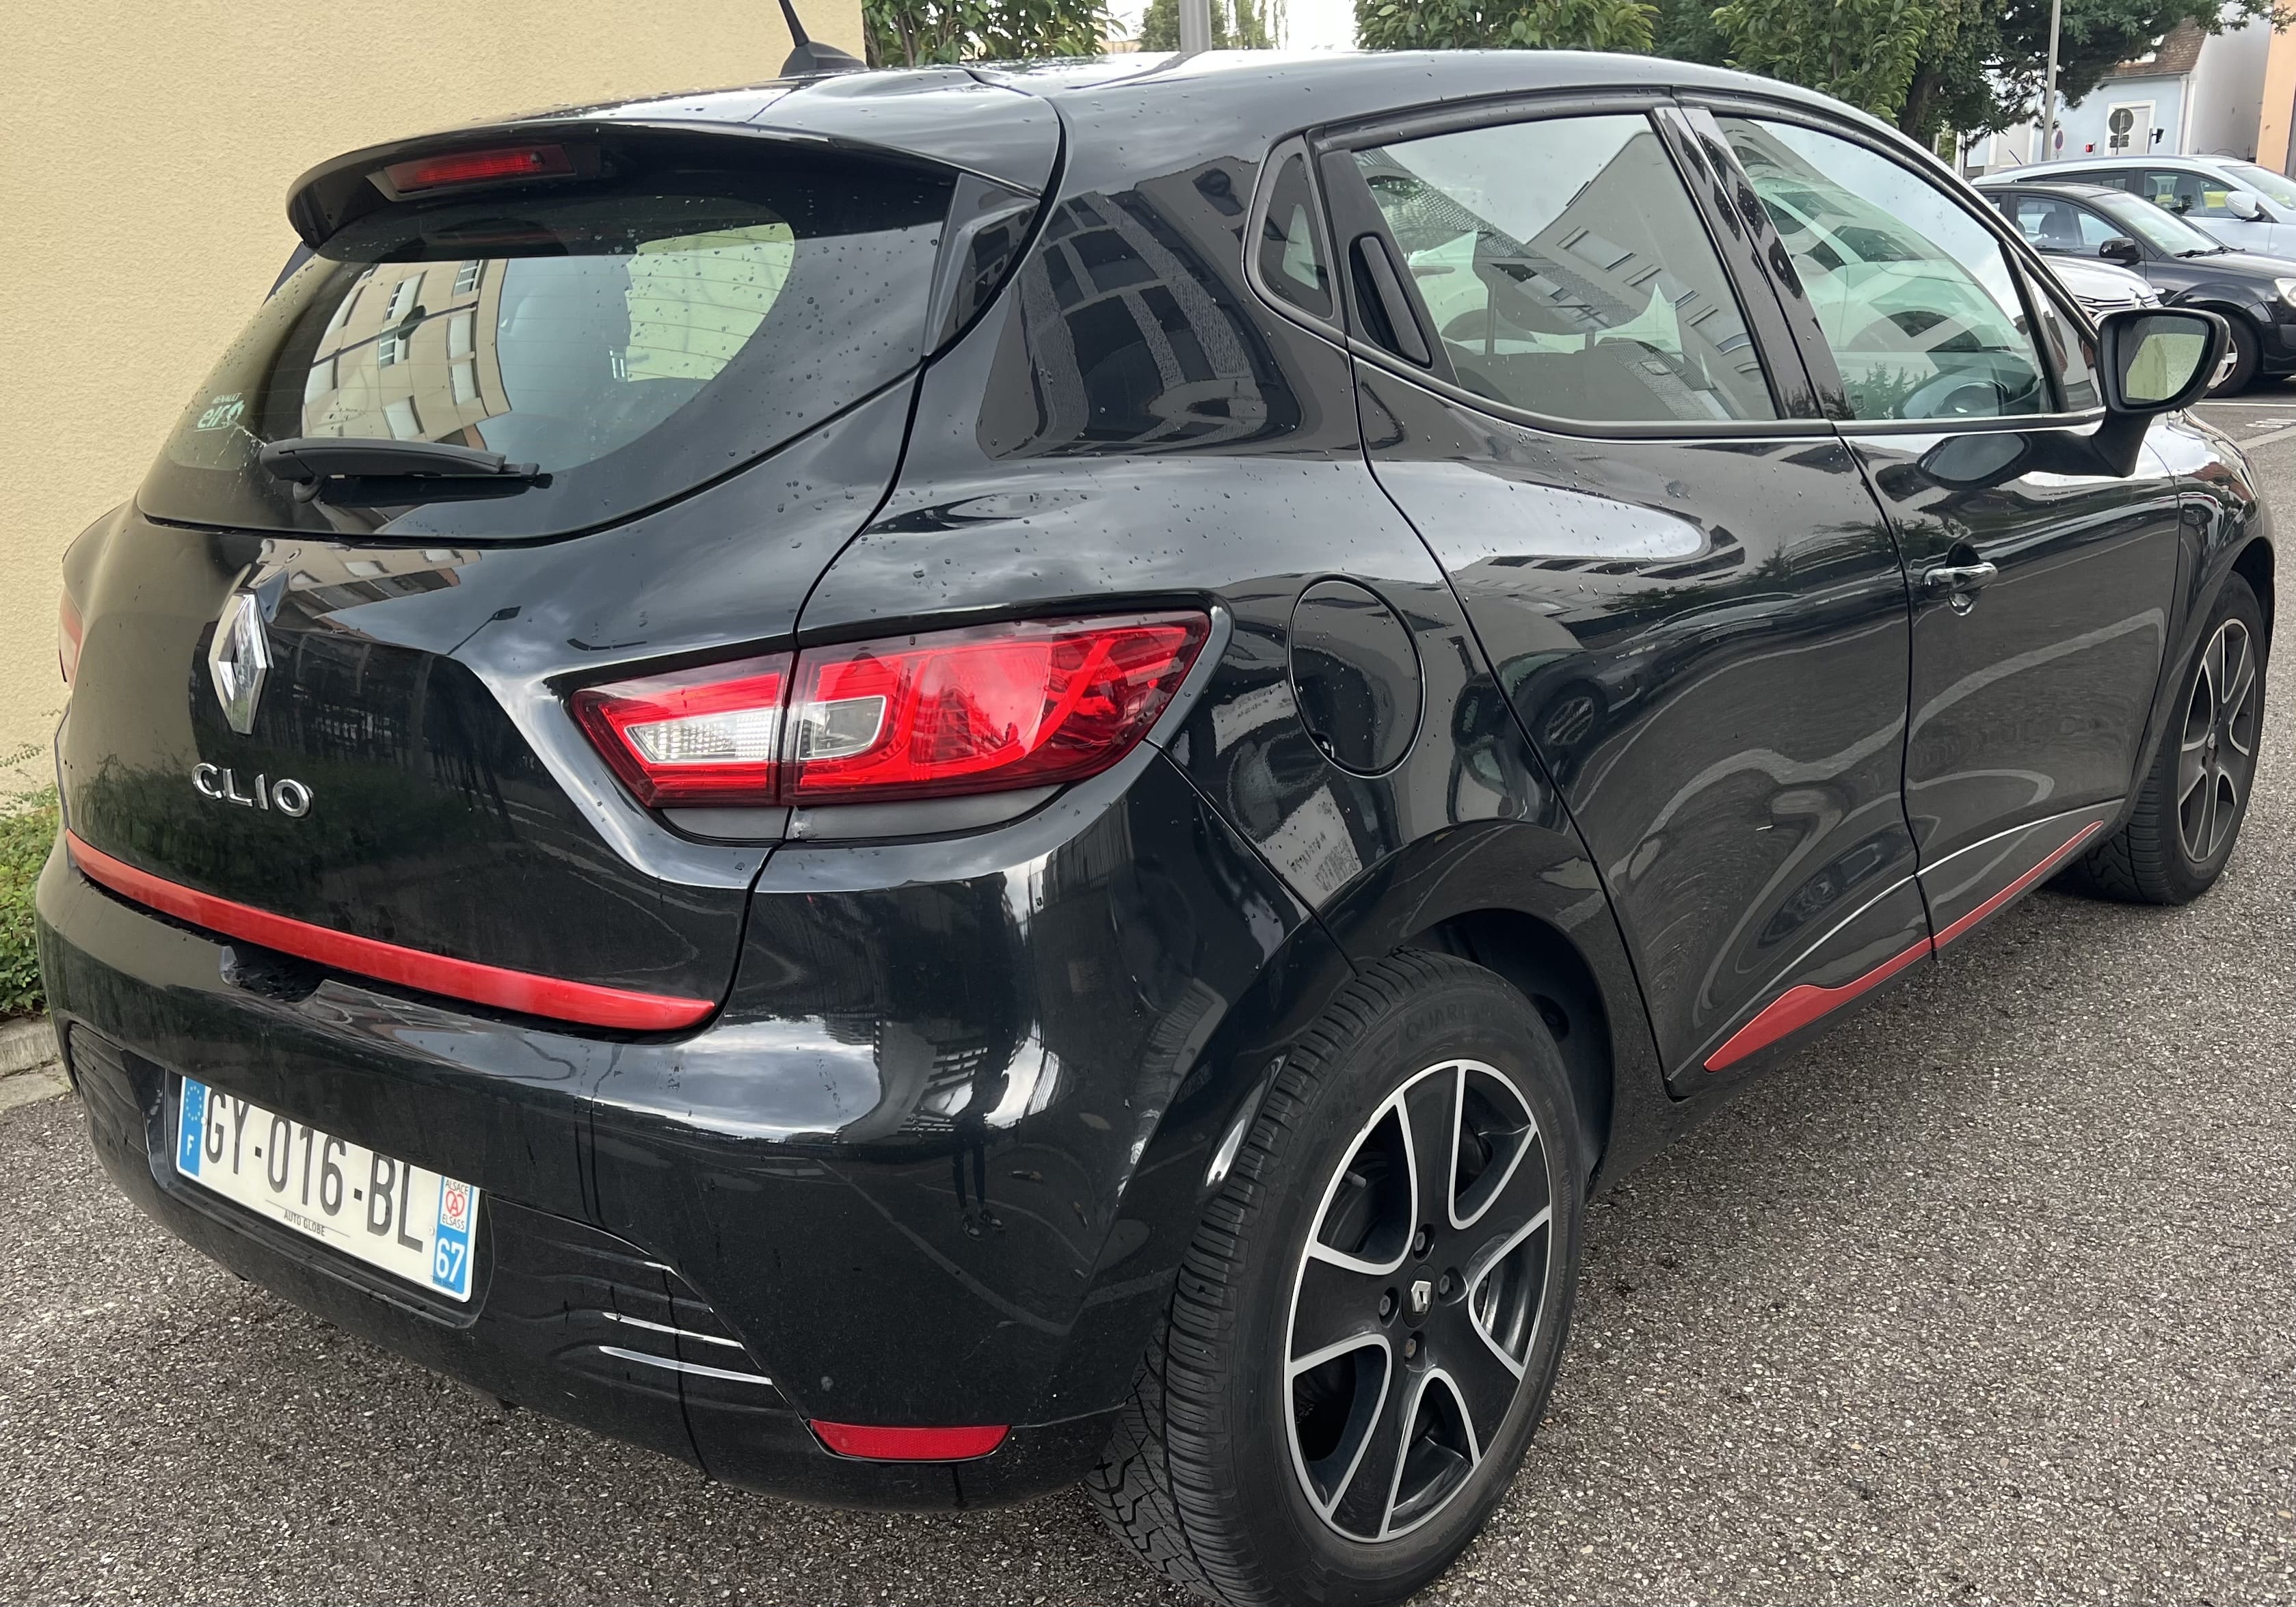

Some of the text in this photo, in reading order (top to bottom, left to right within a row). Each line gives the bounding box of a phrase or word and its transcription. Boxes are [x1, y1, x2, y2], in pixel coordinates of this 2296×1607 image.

[191, 763, 311, 818] CLIO
[186, 1133, 195, 1157] F
[205, 1088, 423, 1252] GY-016-BL
[445, 1179, 469, 1196] ALSACE
[284, 1208, 325, 1237] AUTO GLOBE
[442, 1214, 465, 1230] ELSASS
[436, 1238, 466, 1282] 67
